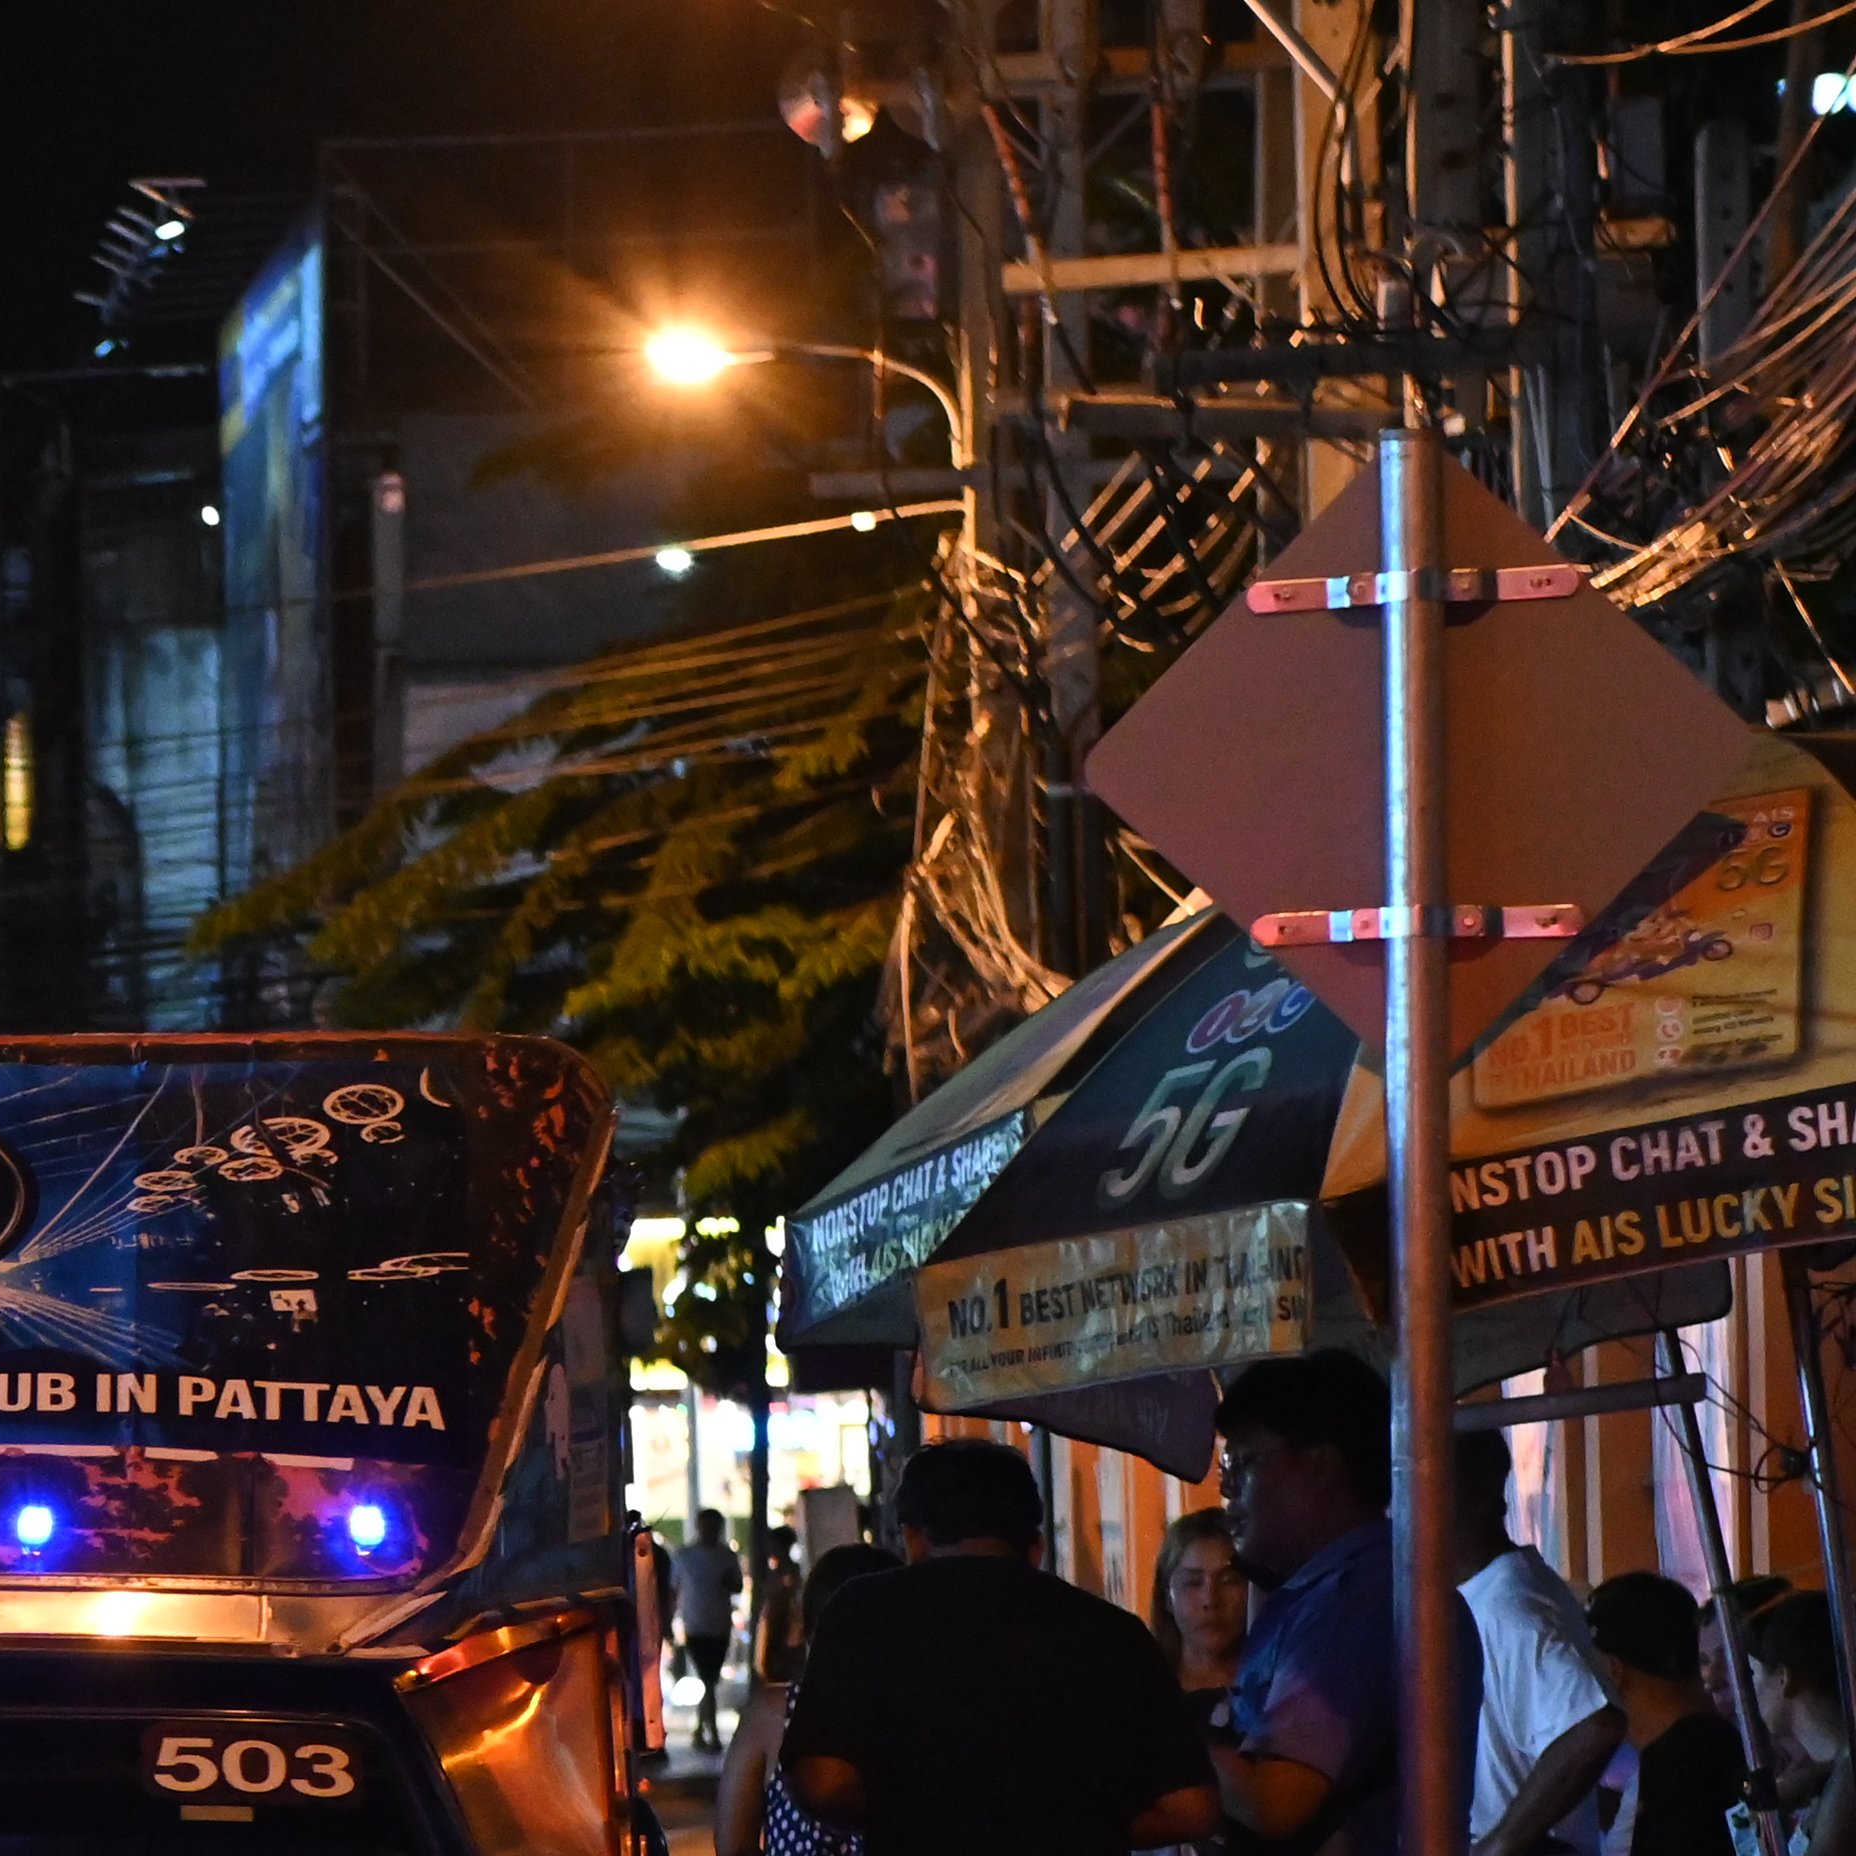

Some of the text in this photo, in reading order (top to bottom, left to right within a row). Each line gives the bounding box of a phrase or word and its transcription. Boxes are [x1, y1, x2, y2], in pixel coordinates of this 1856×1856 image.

[1100, 1046, 1273, 1201] 5G
[1449, 1100, 1856, 1214] NSTOP CHAT & SH
[811, 1181, 890, 1253] NONSTOP
[892, 1159, 935, 1213] CHAT
[934, 1154, 948, 1194] &
[1452, 1225, 1559, 1289] WITH
[1571, 1209, 1648, 1264] AIS
[1655, 1182, 1801, 1249] LUCKY
[1019, 1284, 1078, 1327] BEST
[95, 1373, 158, 1413] IN
[178, 1375, 446, 1431] PATTAYA
[153, 1737, 356, 1798] 503
